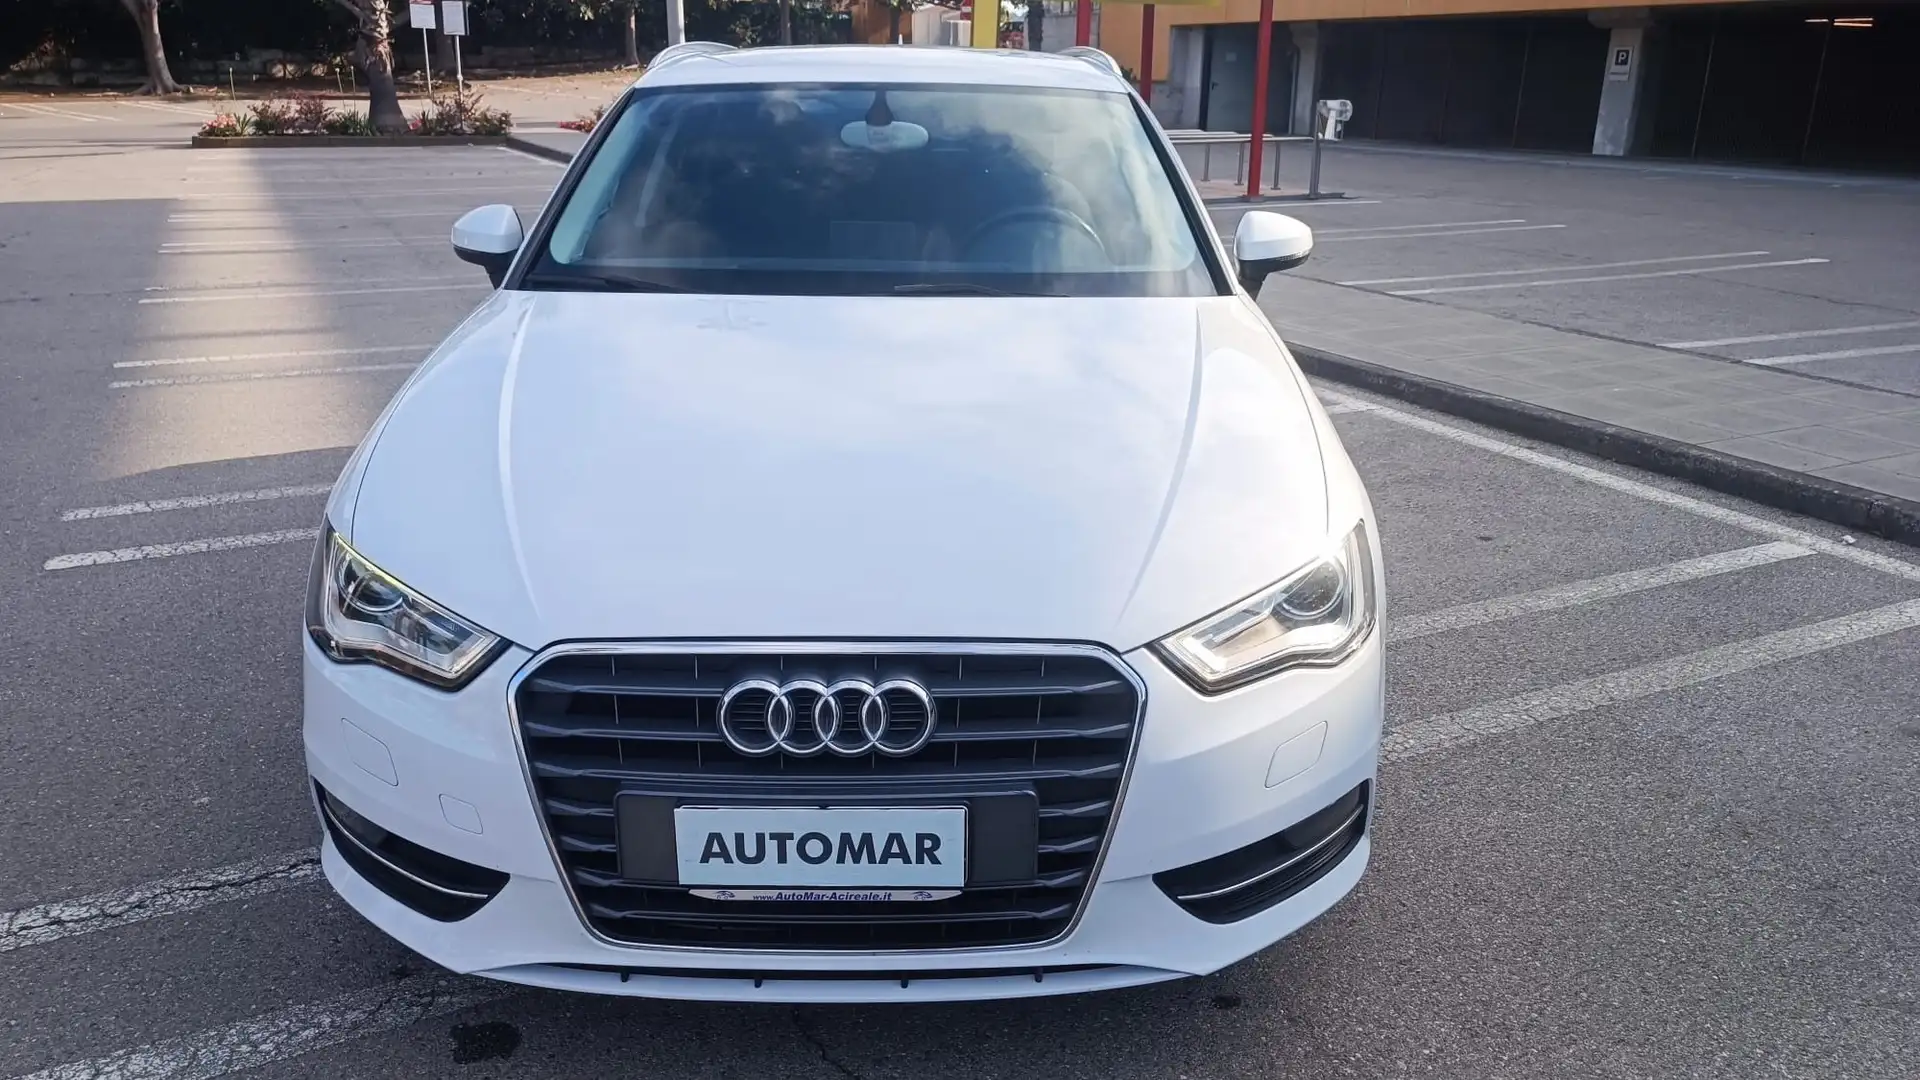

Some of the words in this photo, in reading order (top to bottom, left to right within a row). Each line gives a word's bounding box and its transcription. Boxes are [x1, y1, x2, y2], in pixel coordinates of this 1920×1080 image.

[1618, 52, 1627, 63] P
[699, 832, 942, 864] AUTOMAR
[753, 891, 892, 901] www.AutoMar-Acireale.it
